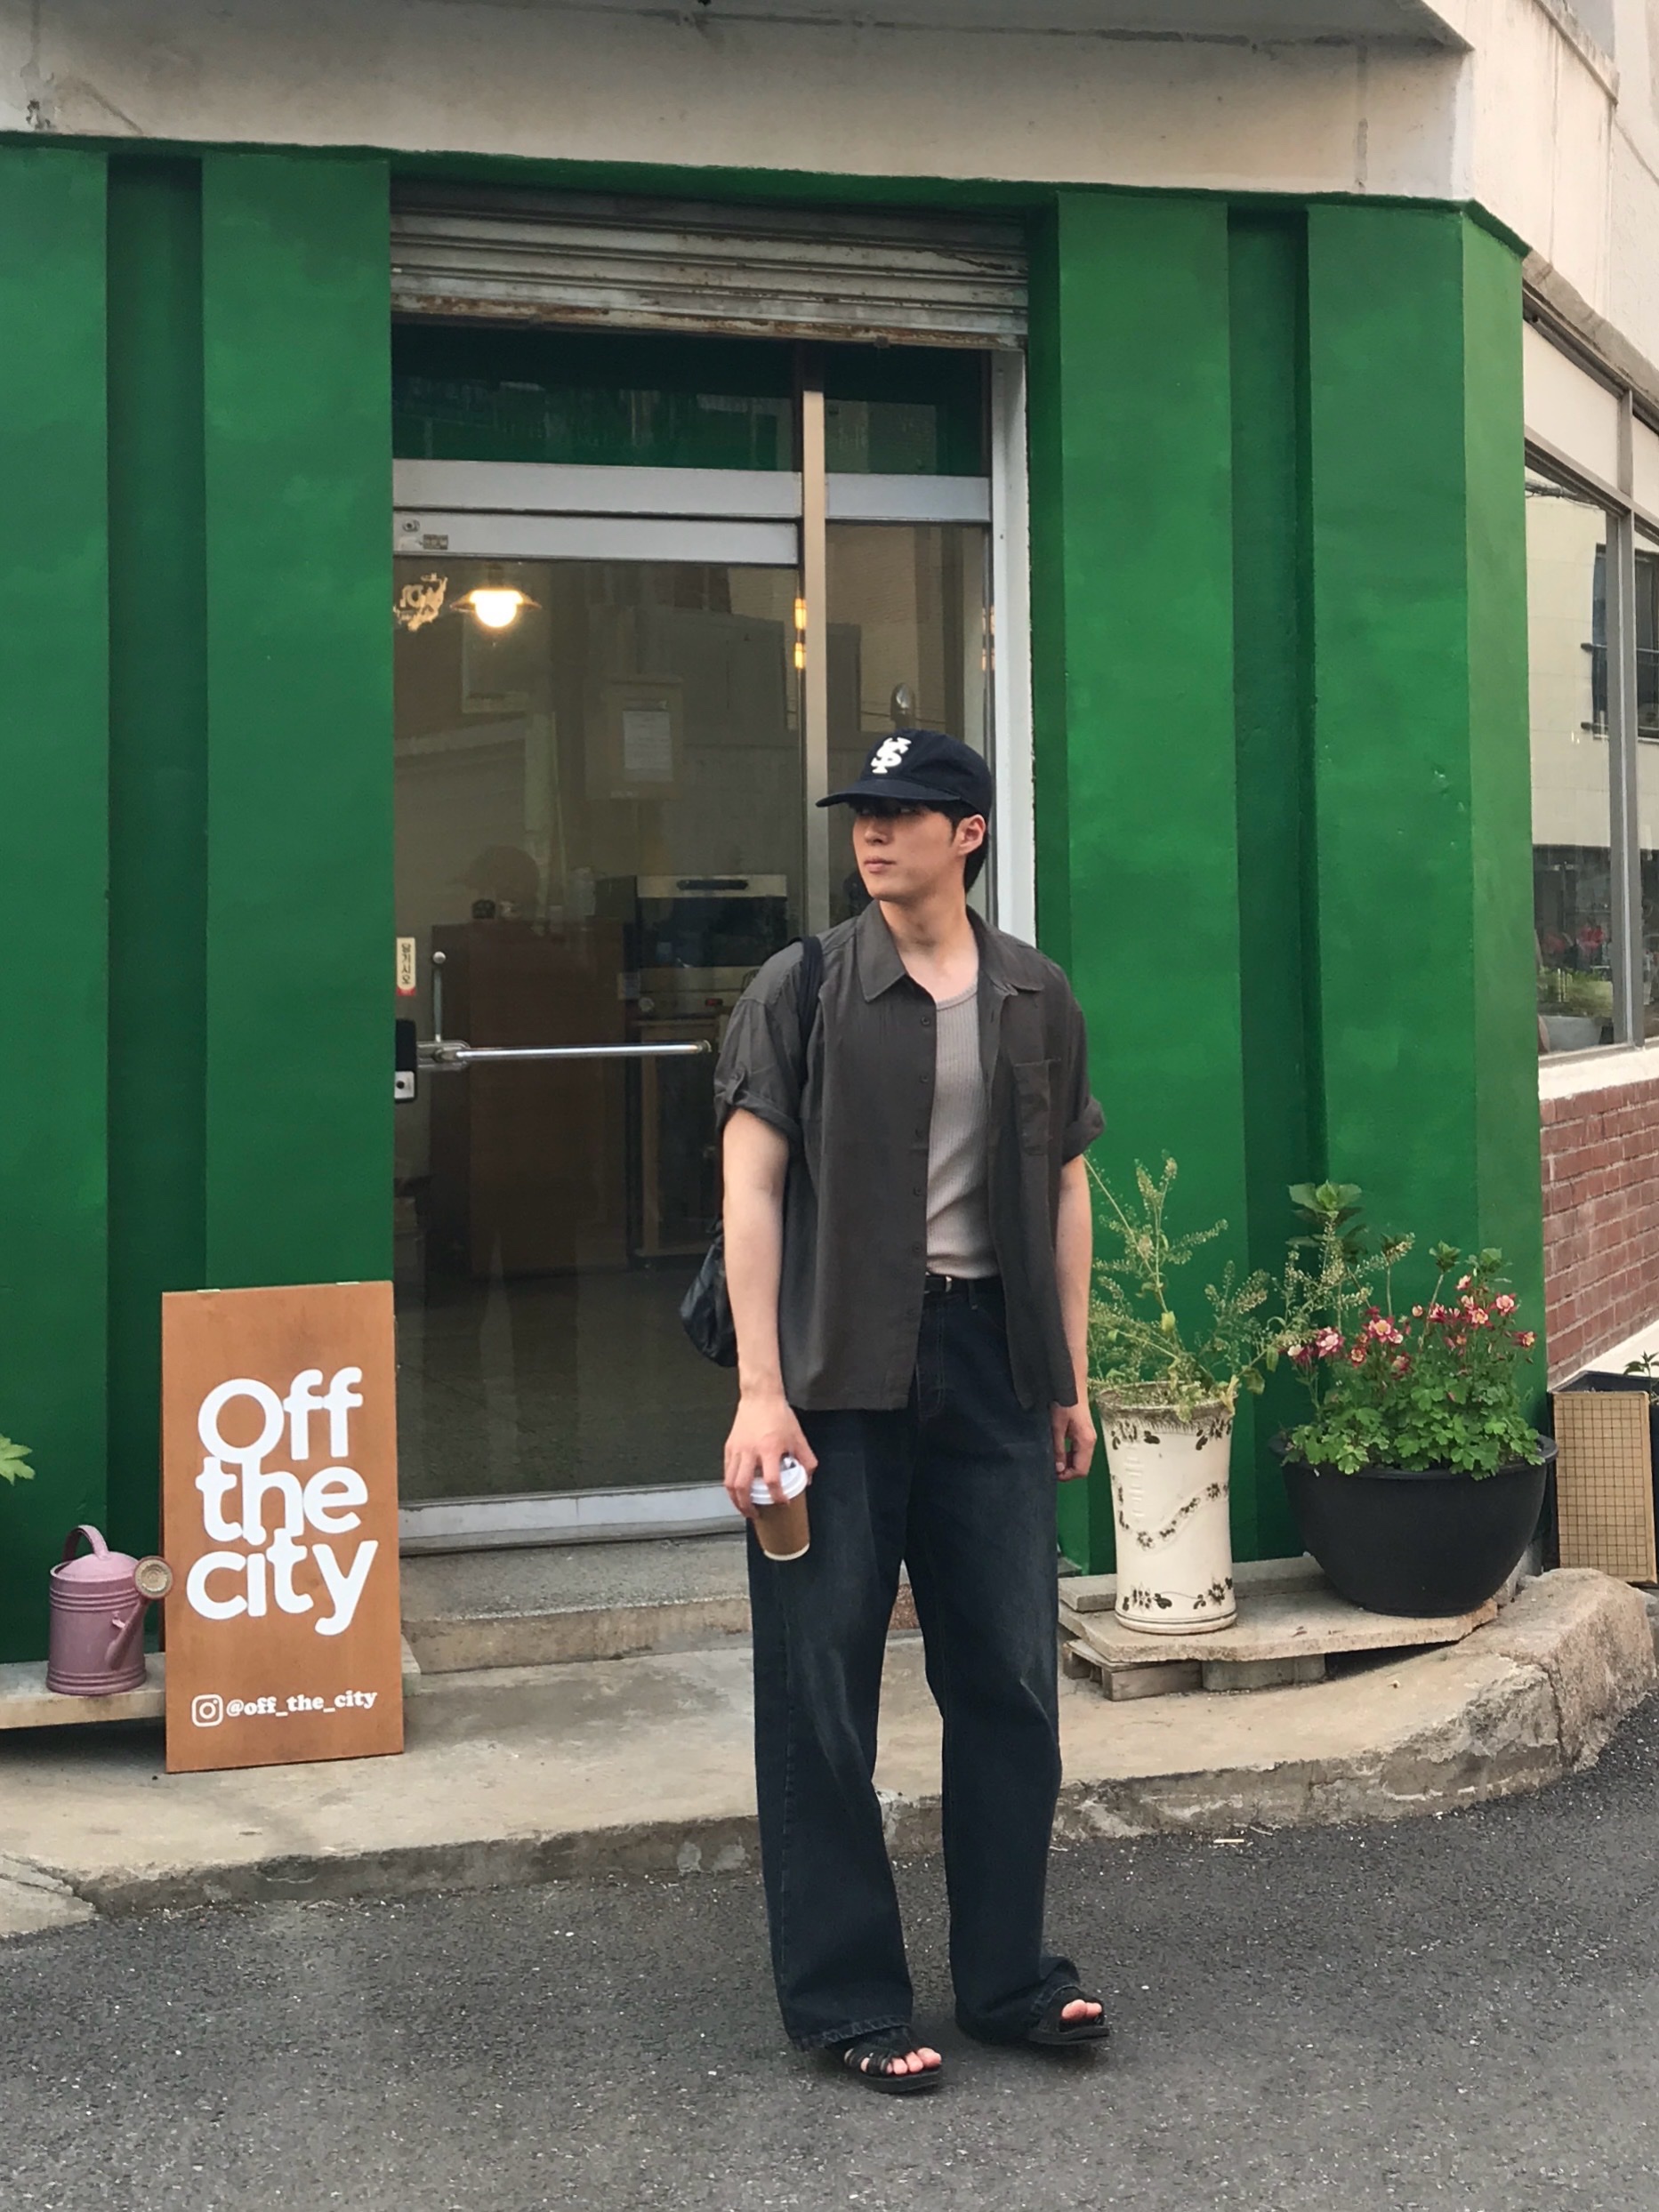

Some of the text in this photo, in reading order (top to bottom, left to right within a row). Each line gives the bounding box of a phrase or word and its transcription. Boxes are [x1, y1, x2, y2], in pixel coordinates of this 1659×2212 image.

[197, 1366, 363, 1464] Off
[195, 1456, 368, 1546] the
[186, 1528, 378, 1636] city
[226, 1690, 377, 1717] @off_the_city
